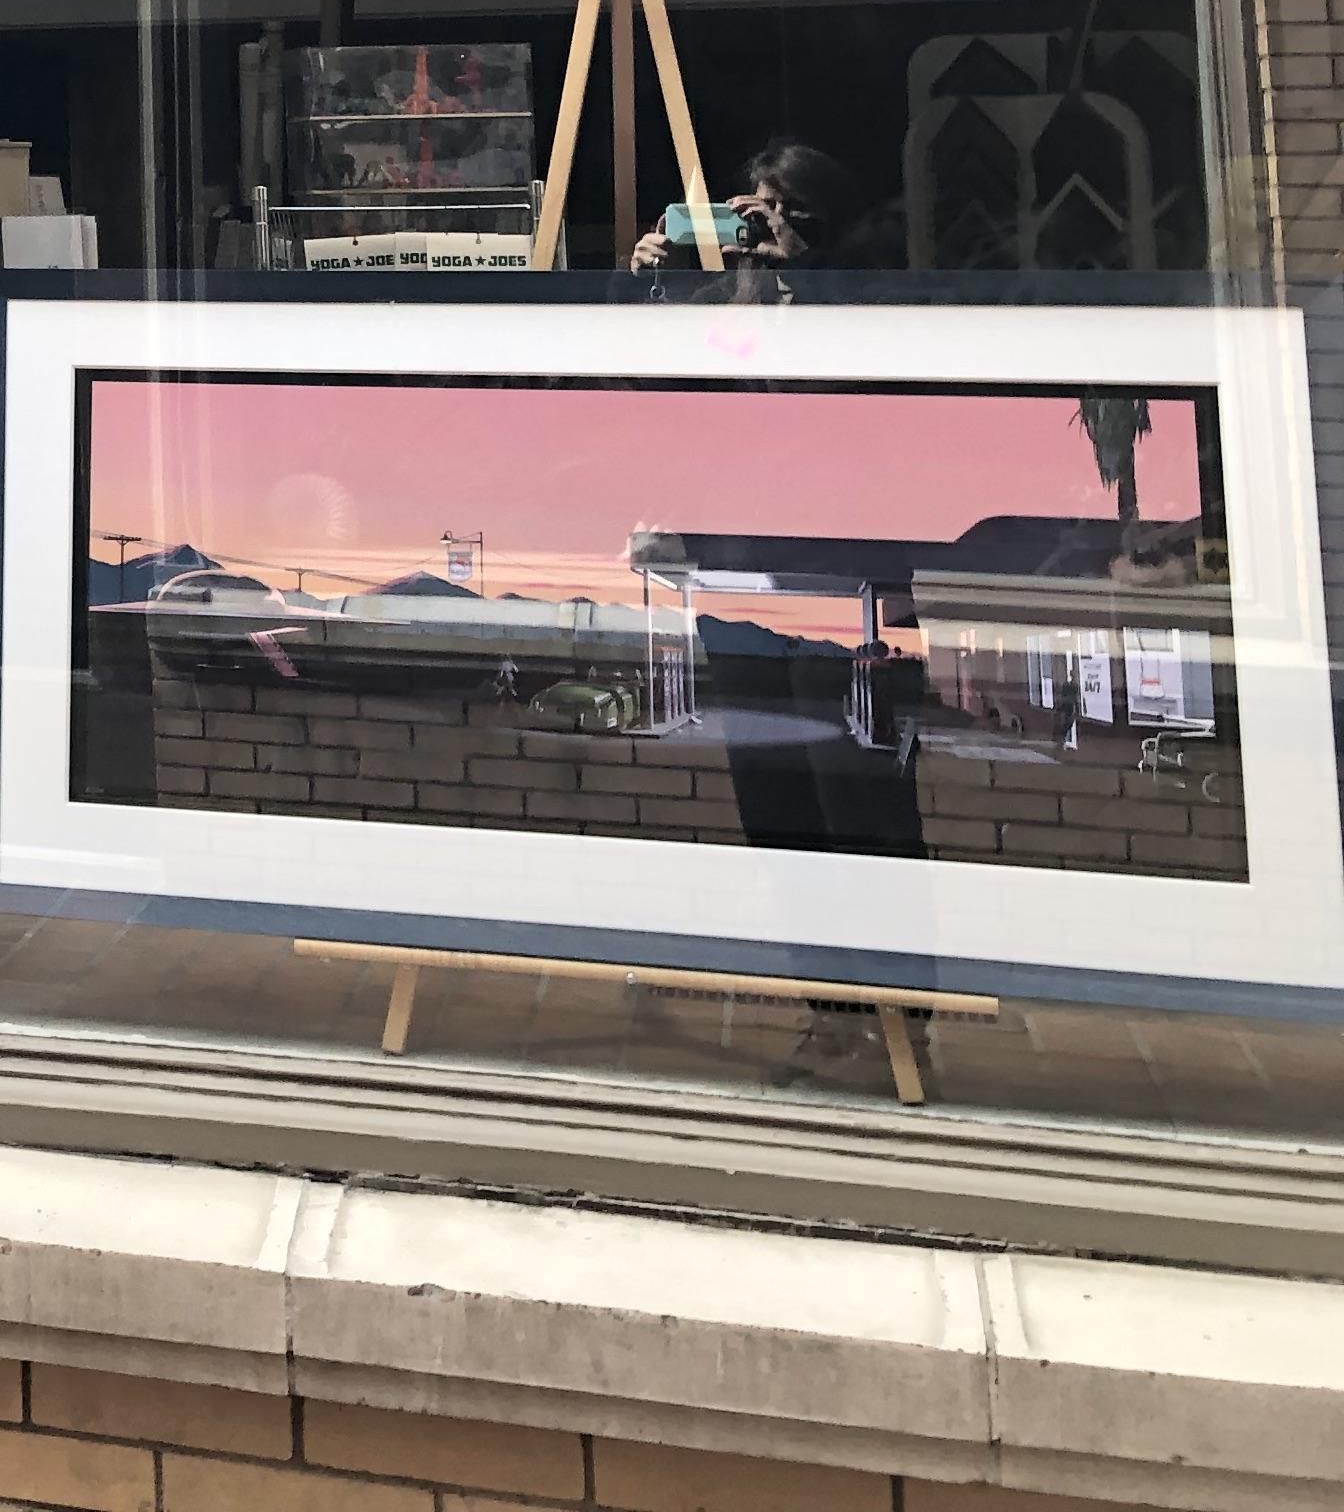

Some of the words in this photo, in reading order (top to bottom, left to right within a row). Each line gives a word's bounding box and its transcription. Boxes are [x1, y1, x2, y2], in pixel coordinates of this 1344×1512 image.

[310, 257, 351, 271] YOGA
[432, 255, 473, 268] YOGA
[488, 255, 527, 267] JOES
